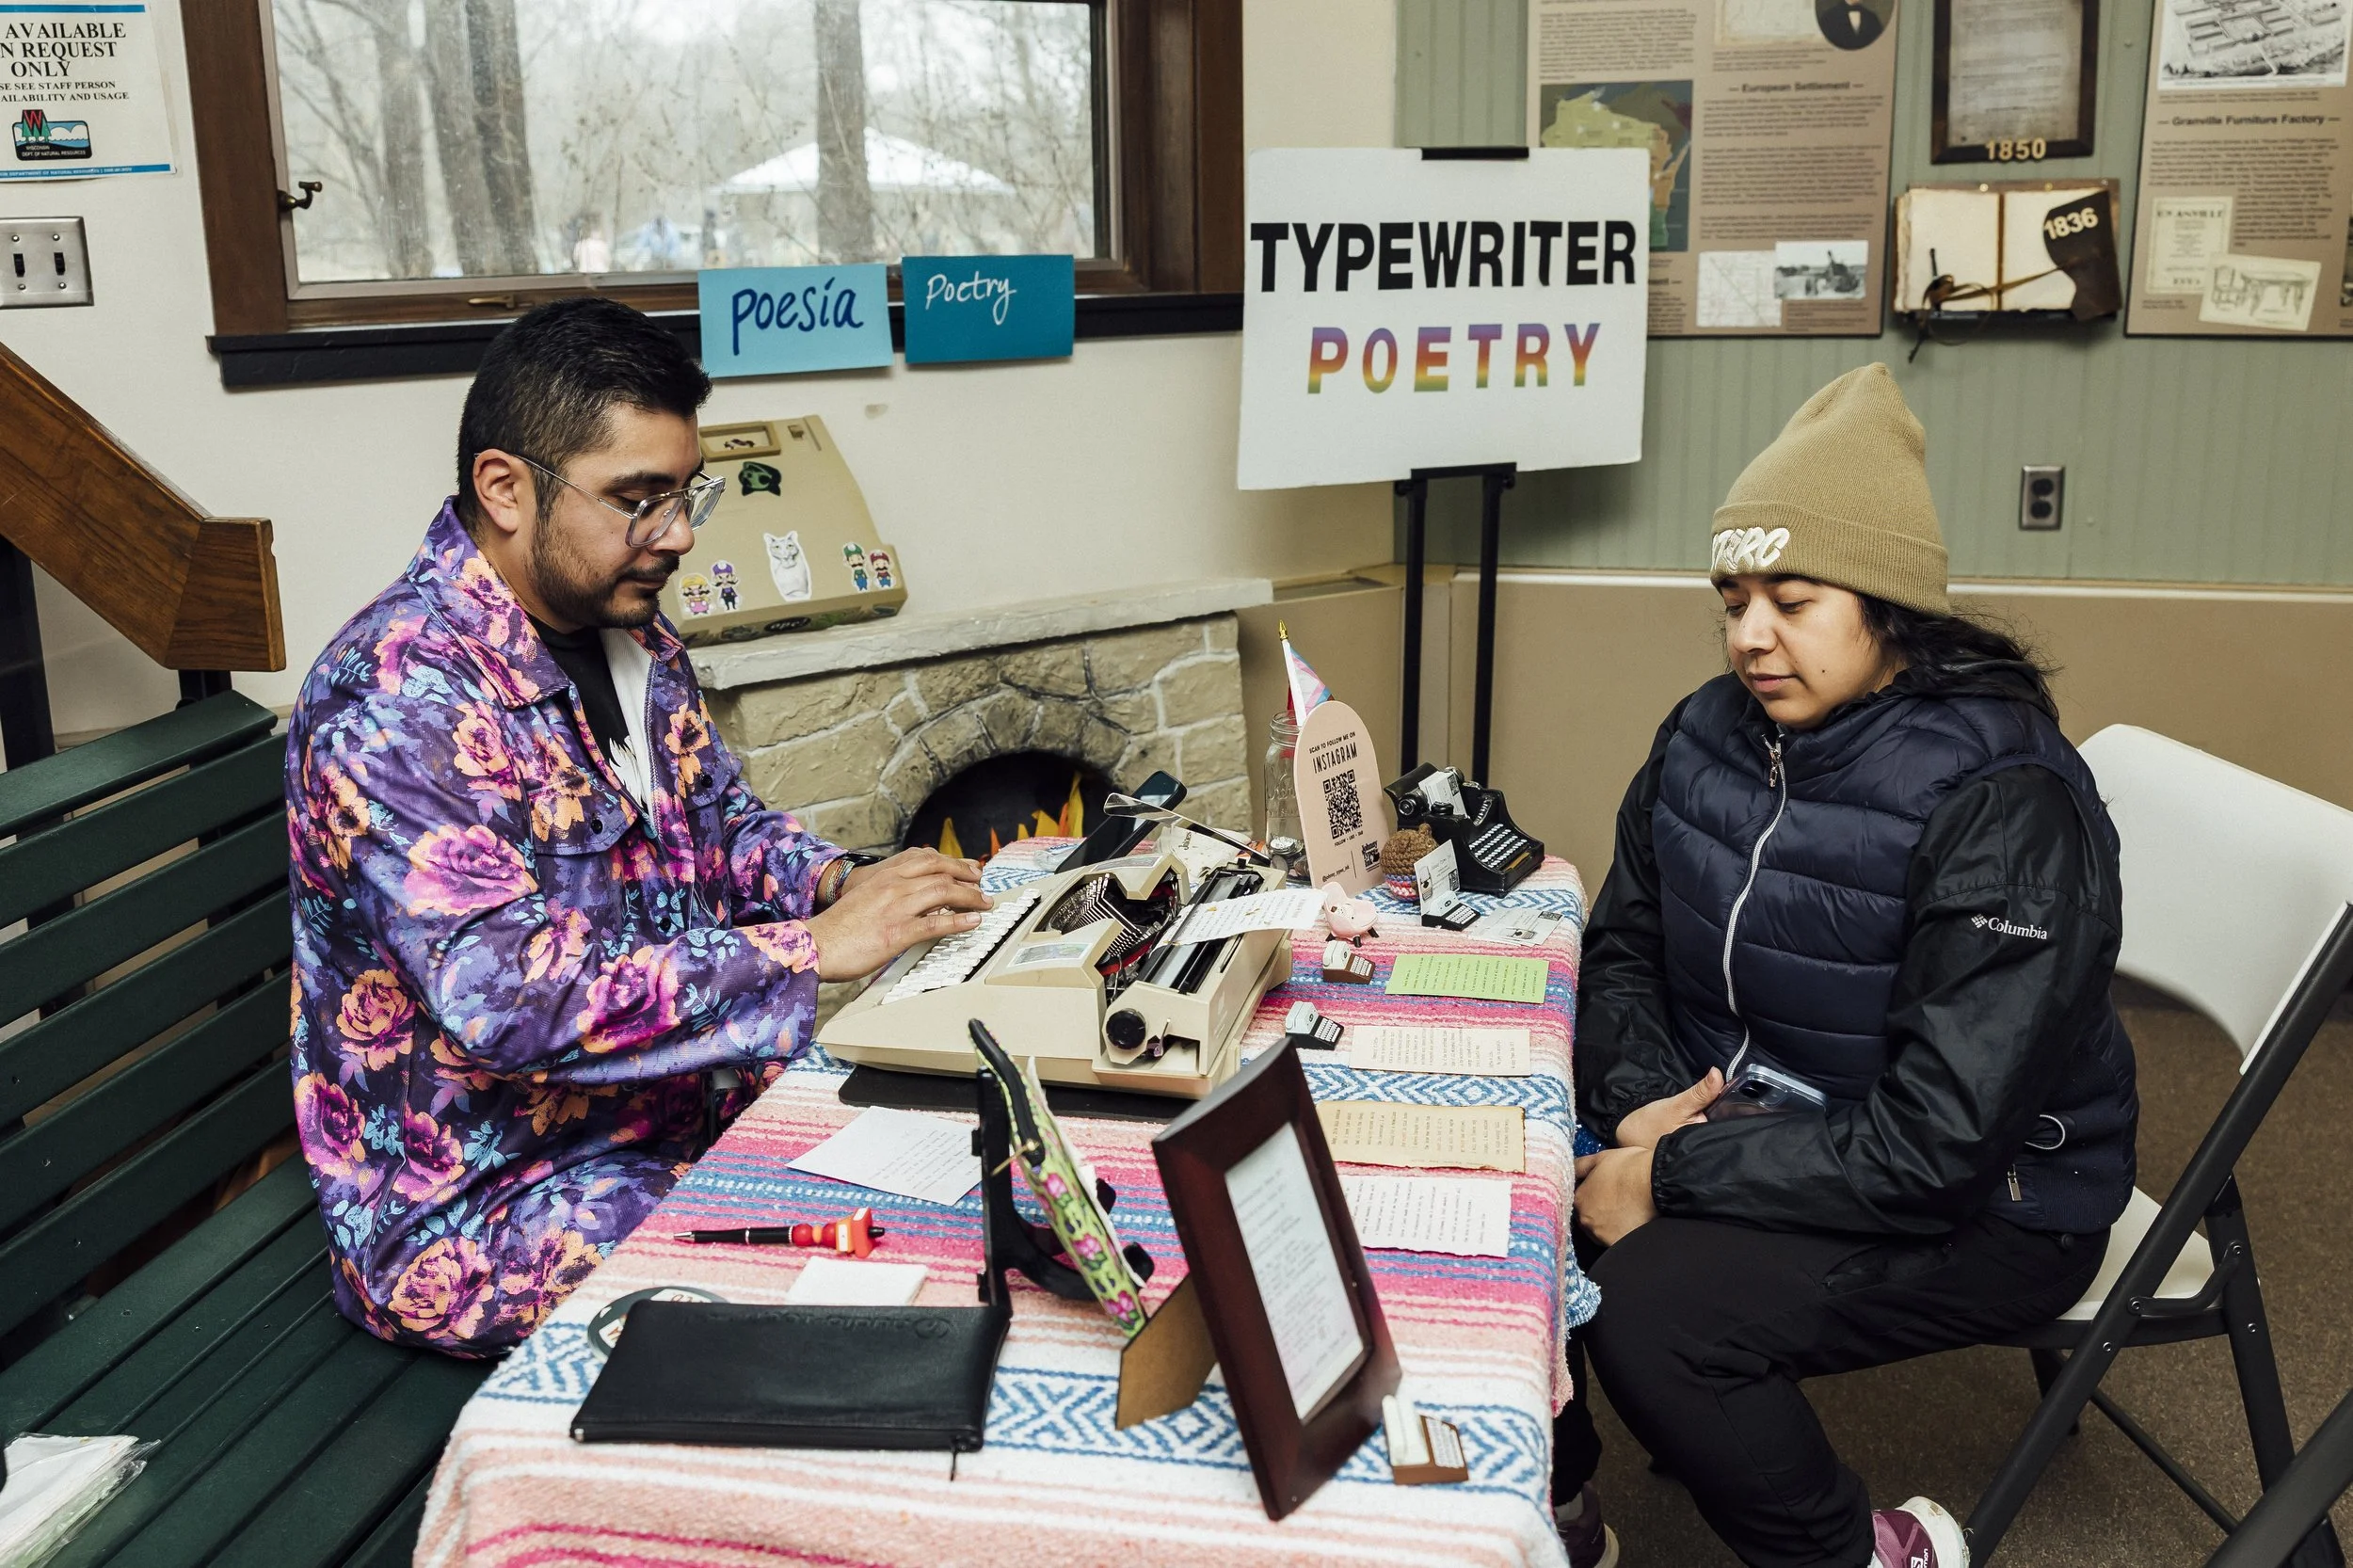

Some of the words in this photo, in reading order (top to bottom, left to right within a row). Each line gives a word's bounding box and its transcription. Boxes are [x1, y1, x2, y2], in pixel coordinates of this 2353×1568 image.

[5, 23, 126, 39] AVAILABLE
[21, 41, 117, 61] REQUEST
[10, 61, 71, 77] ONLY
[38, 82, 72, 90] STAFF
[74, 81, 116, 89] PERSON
[70, 92, 91, 102] AND
[93, 91, 129, 101] USAGE
[2172, 116, 2222, 126] Granville
[2225, 114, 2278, 125] Furniture
[2281, 113, 2325, 126] Factory
[1985, 137, 2047, 161] 1850
[2043, 206, 2099, 240] 1836
[1250, 220, 1637, 293] TYPEWRITER
[924, 270, 1017, 326] Poetry
[730, 276, 865, 357] poesía
[1307, 322, 1601, 395] POETRY
[1309, 744, 1321, 754] SCAN
[1321, 742, 1327, 750] TO
[1326, 736, 1343, 747] FOLLOW
[1312, 742, 1358, 774] INSTAGRAM
[1988, 917, 2048, 940] Columbia
